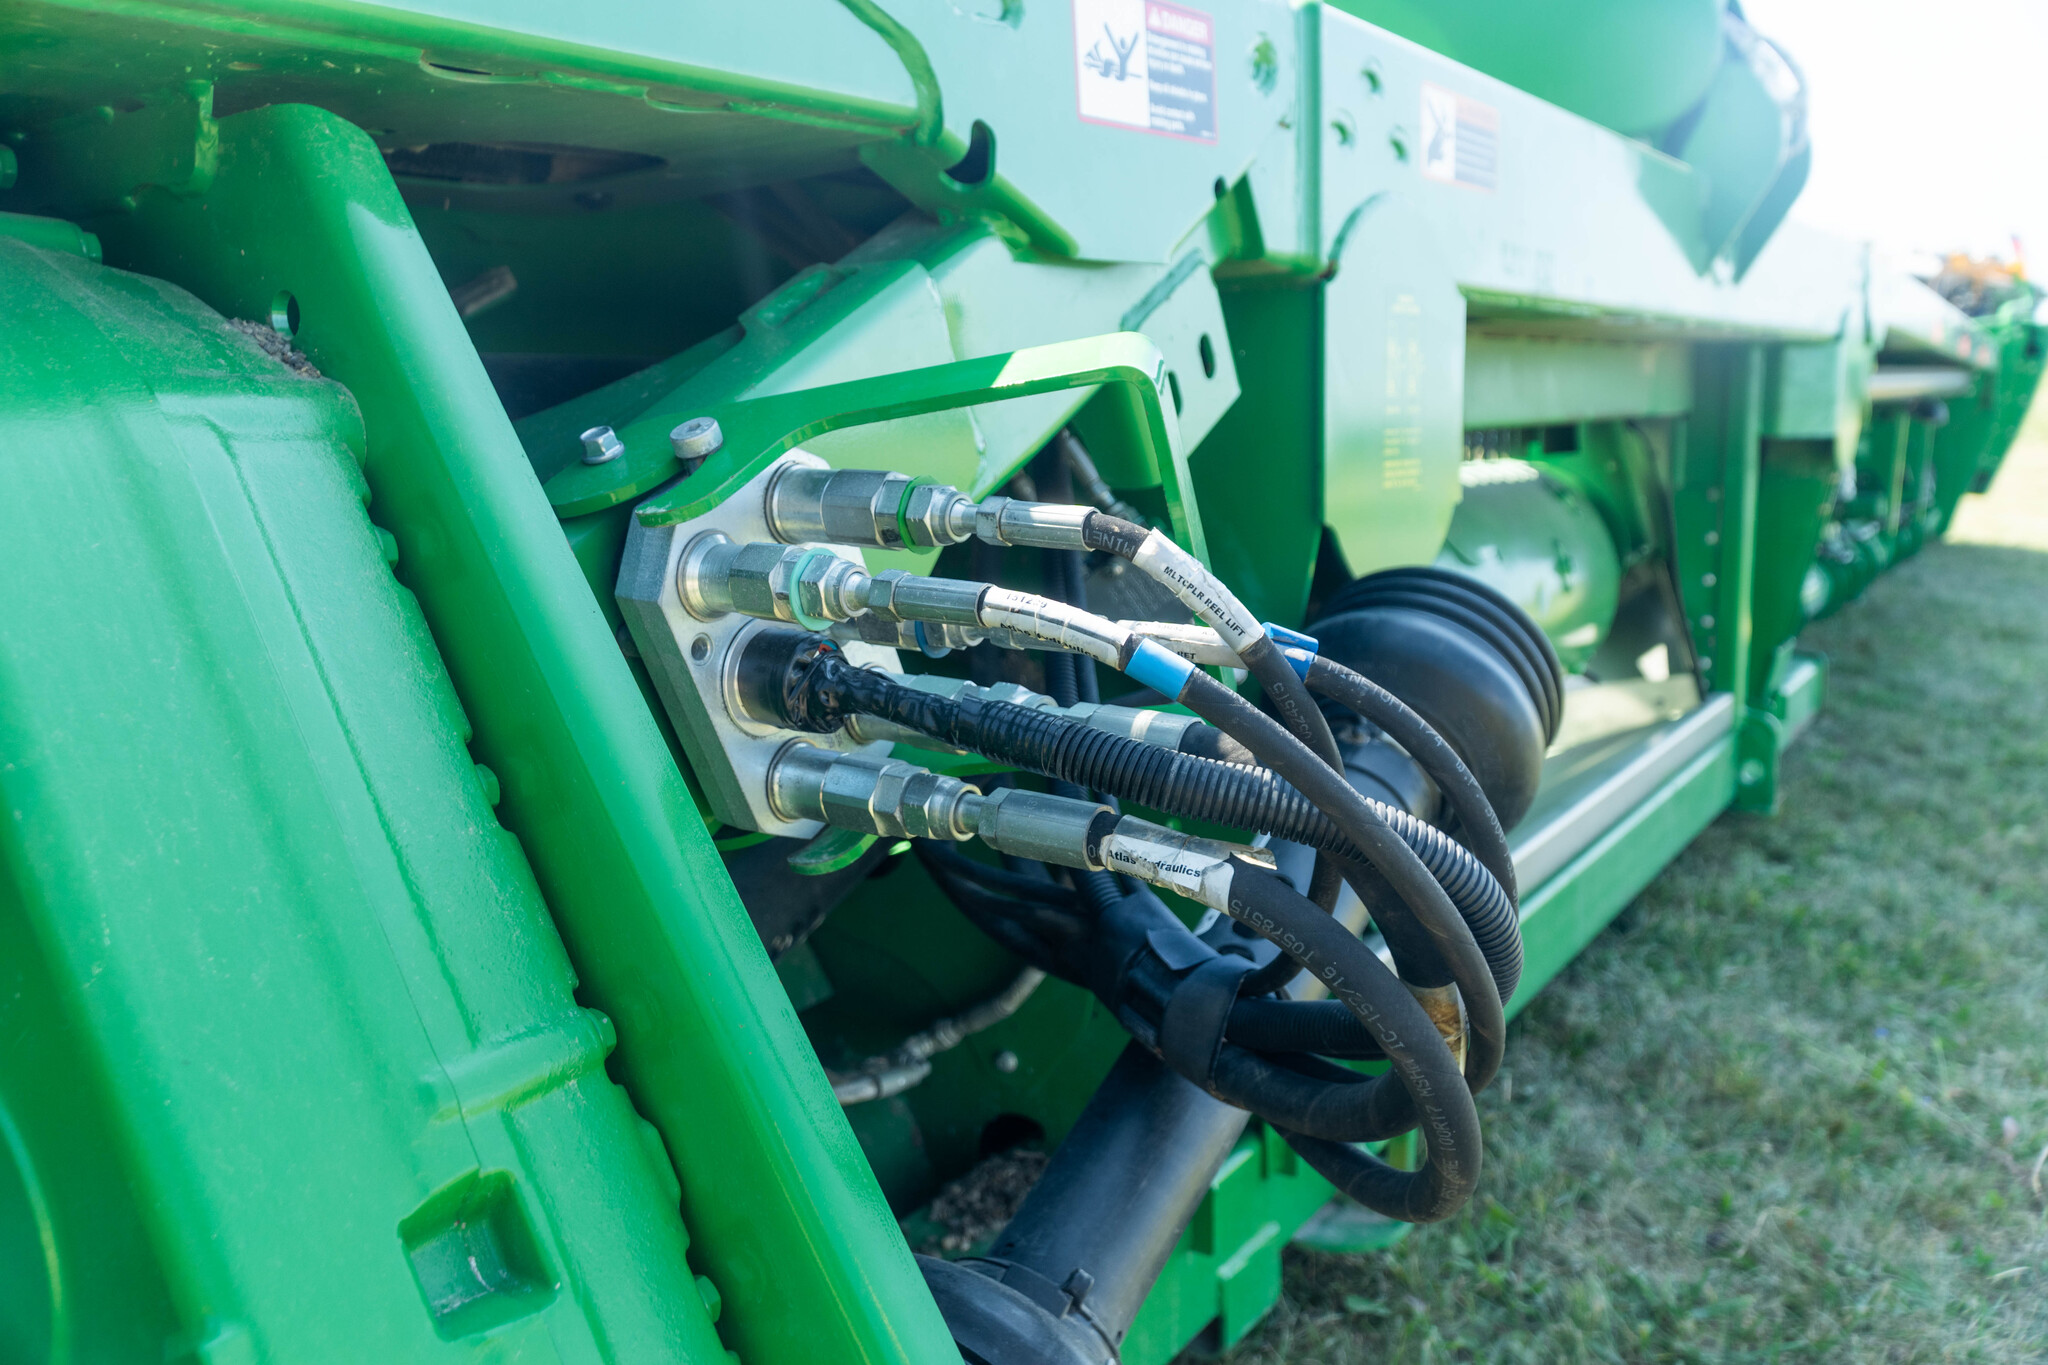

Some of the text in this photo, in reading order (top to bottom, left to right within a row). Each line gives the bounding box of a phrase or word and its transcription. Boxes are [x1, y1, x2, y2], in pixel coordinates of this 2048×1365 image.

[1163, 566, 1205, 601] MLTCPLR
[1203, 597, 1226, 621] REEL
[1225, 618, 1246, 637] LIFT
[1107, 849, 1137, 866] Atlas
[1229, 898, 1316, 964] T0578515
